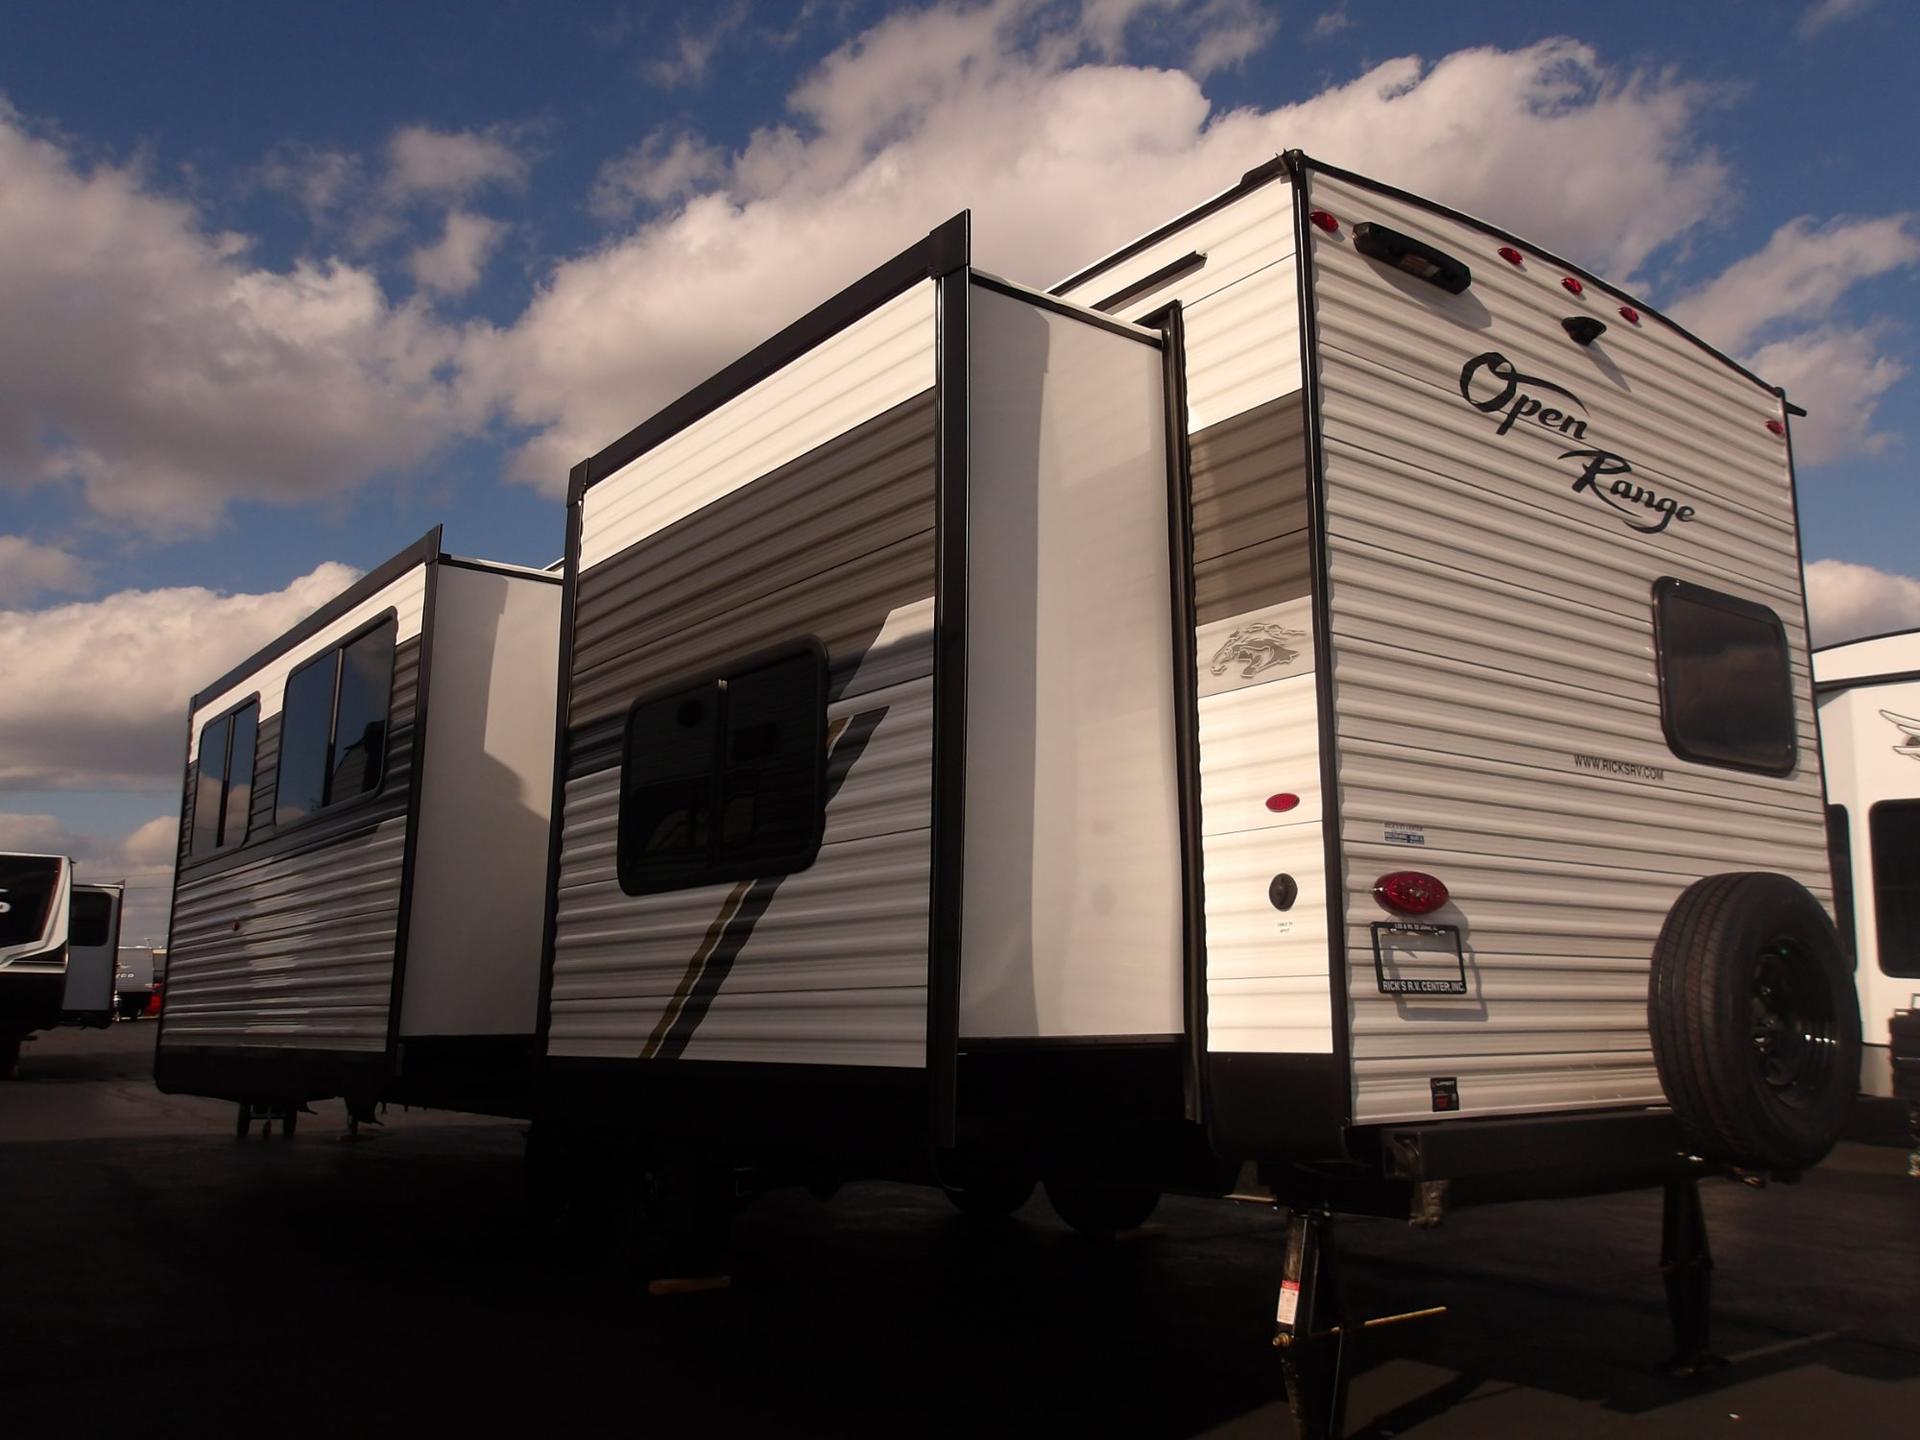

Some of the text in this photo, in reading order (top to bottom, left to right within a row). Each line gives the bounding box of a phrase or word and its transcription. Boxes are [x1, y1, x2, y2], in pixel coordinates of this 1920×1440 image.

[1460, 352, 1590, 439] Open
[1557, 450, 1696, 534] Range
[1573, 753, 1665, 780] WWW.RICKSRV.COM
